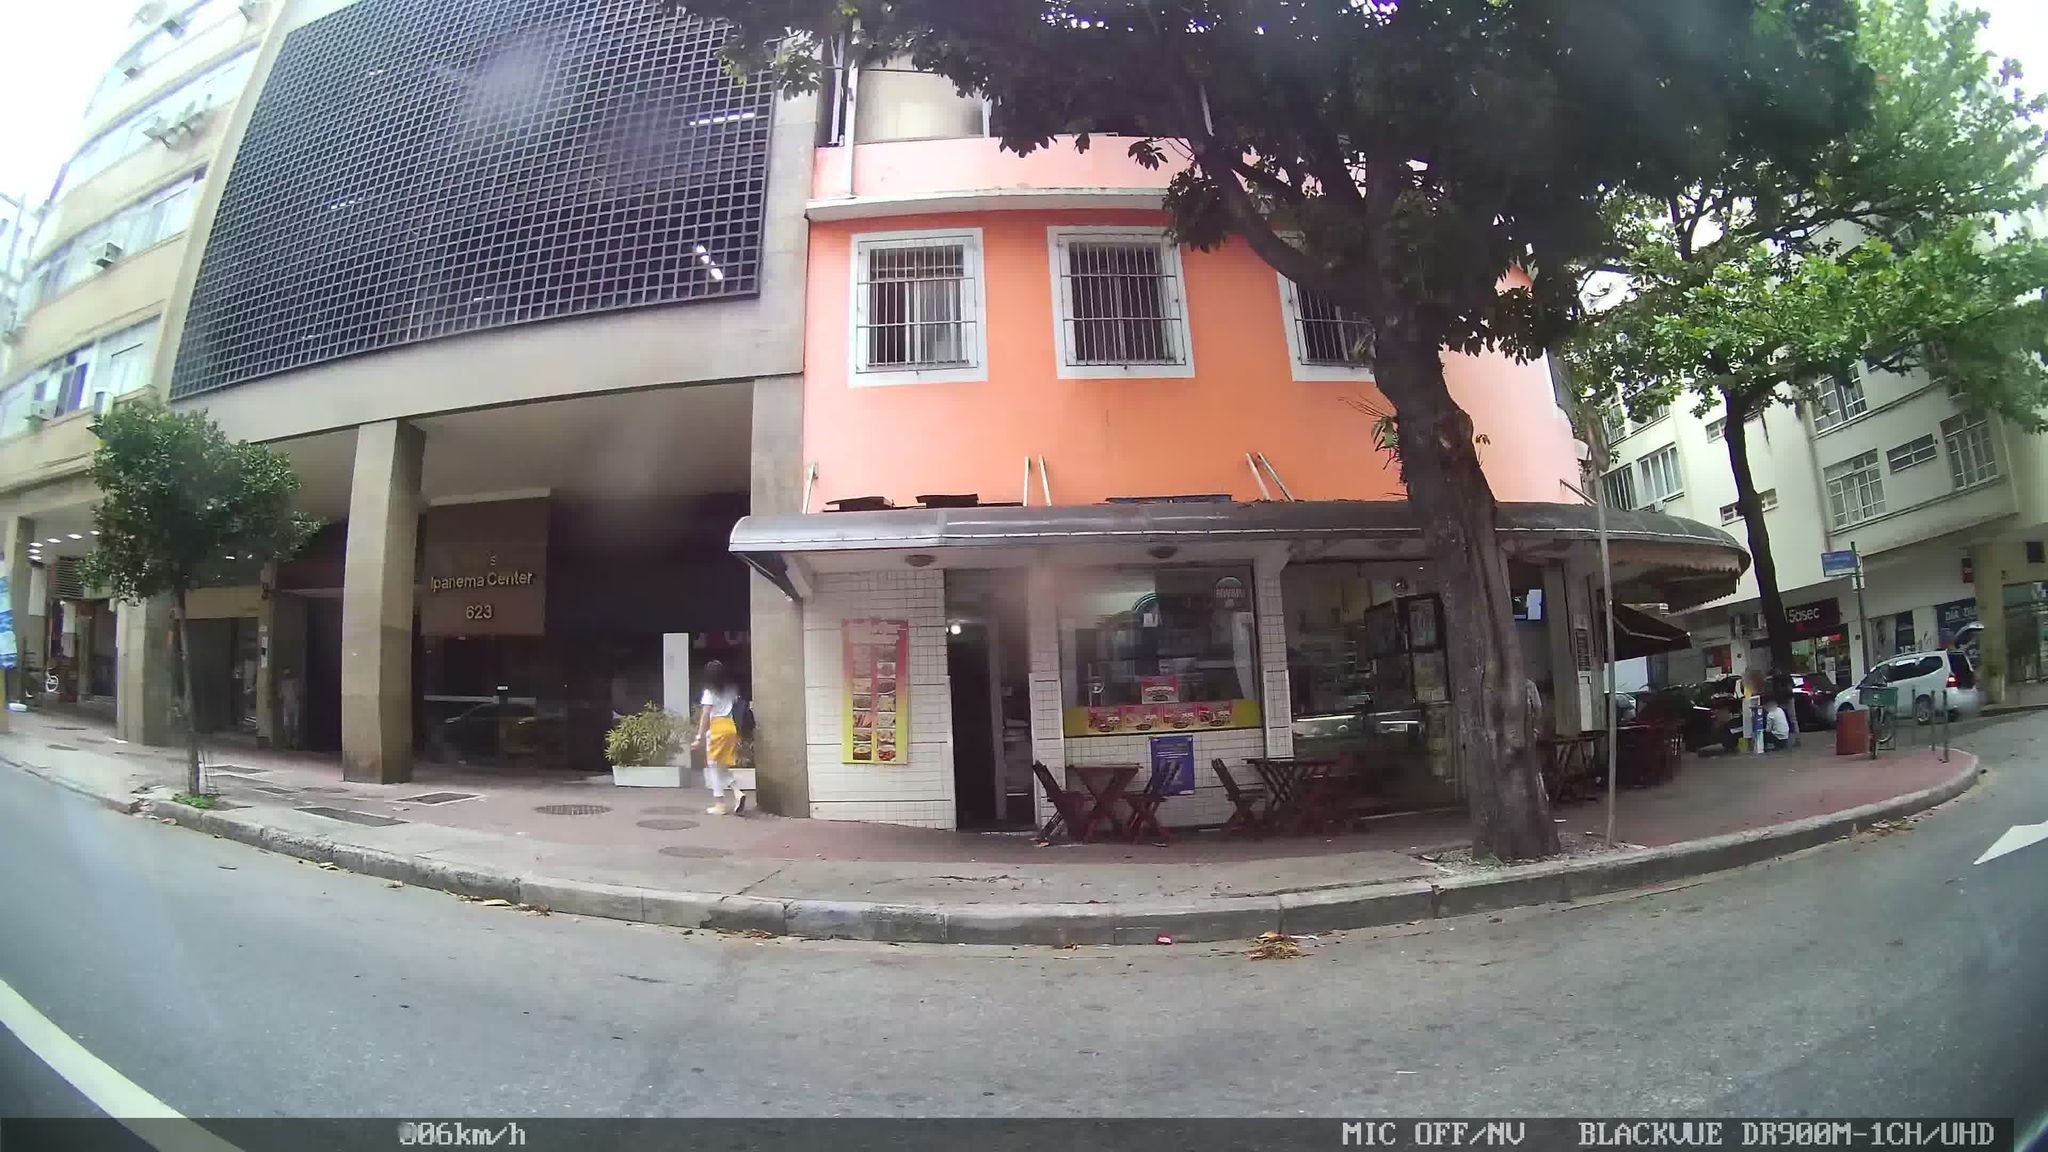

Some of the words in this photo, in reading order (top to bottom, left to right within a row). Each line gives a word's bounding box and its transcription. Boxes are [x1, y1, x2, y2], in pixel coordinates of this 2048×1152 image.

[431, 576, 485, 592] Ipanema
[487, 570, 533, 586] Center
[466, 604, 493, 619] 623
